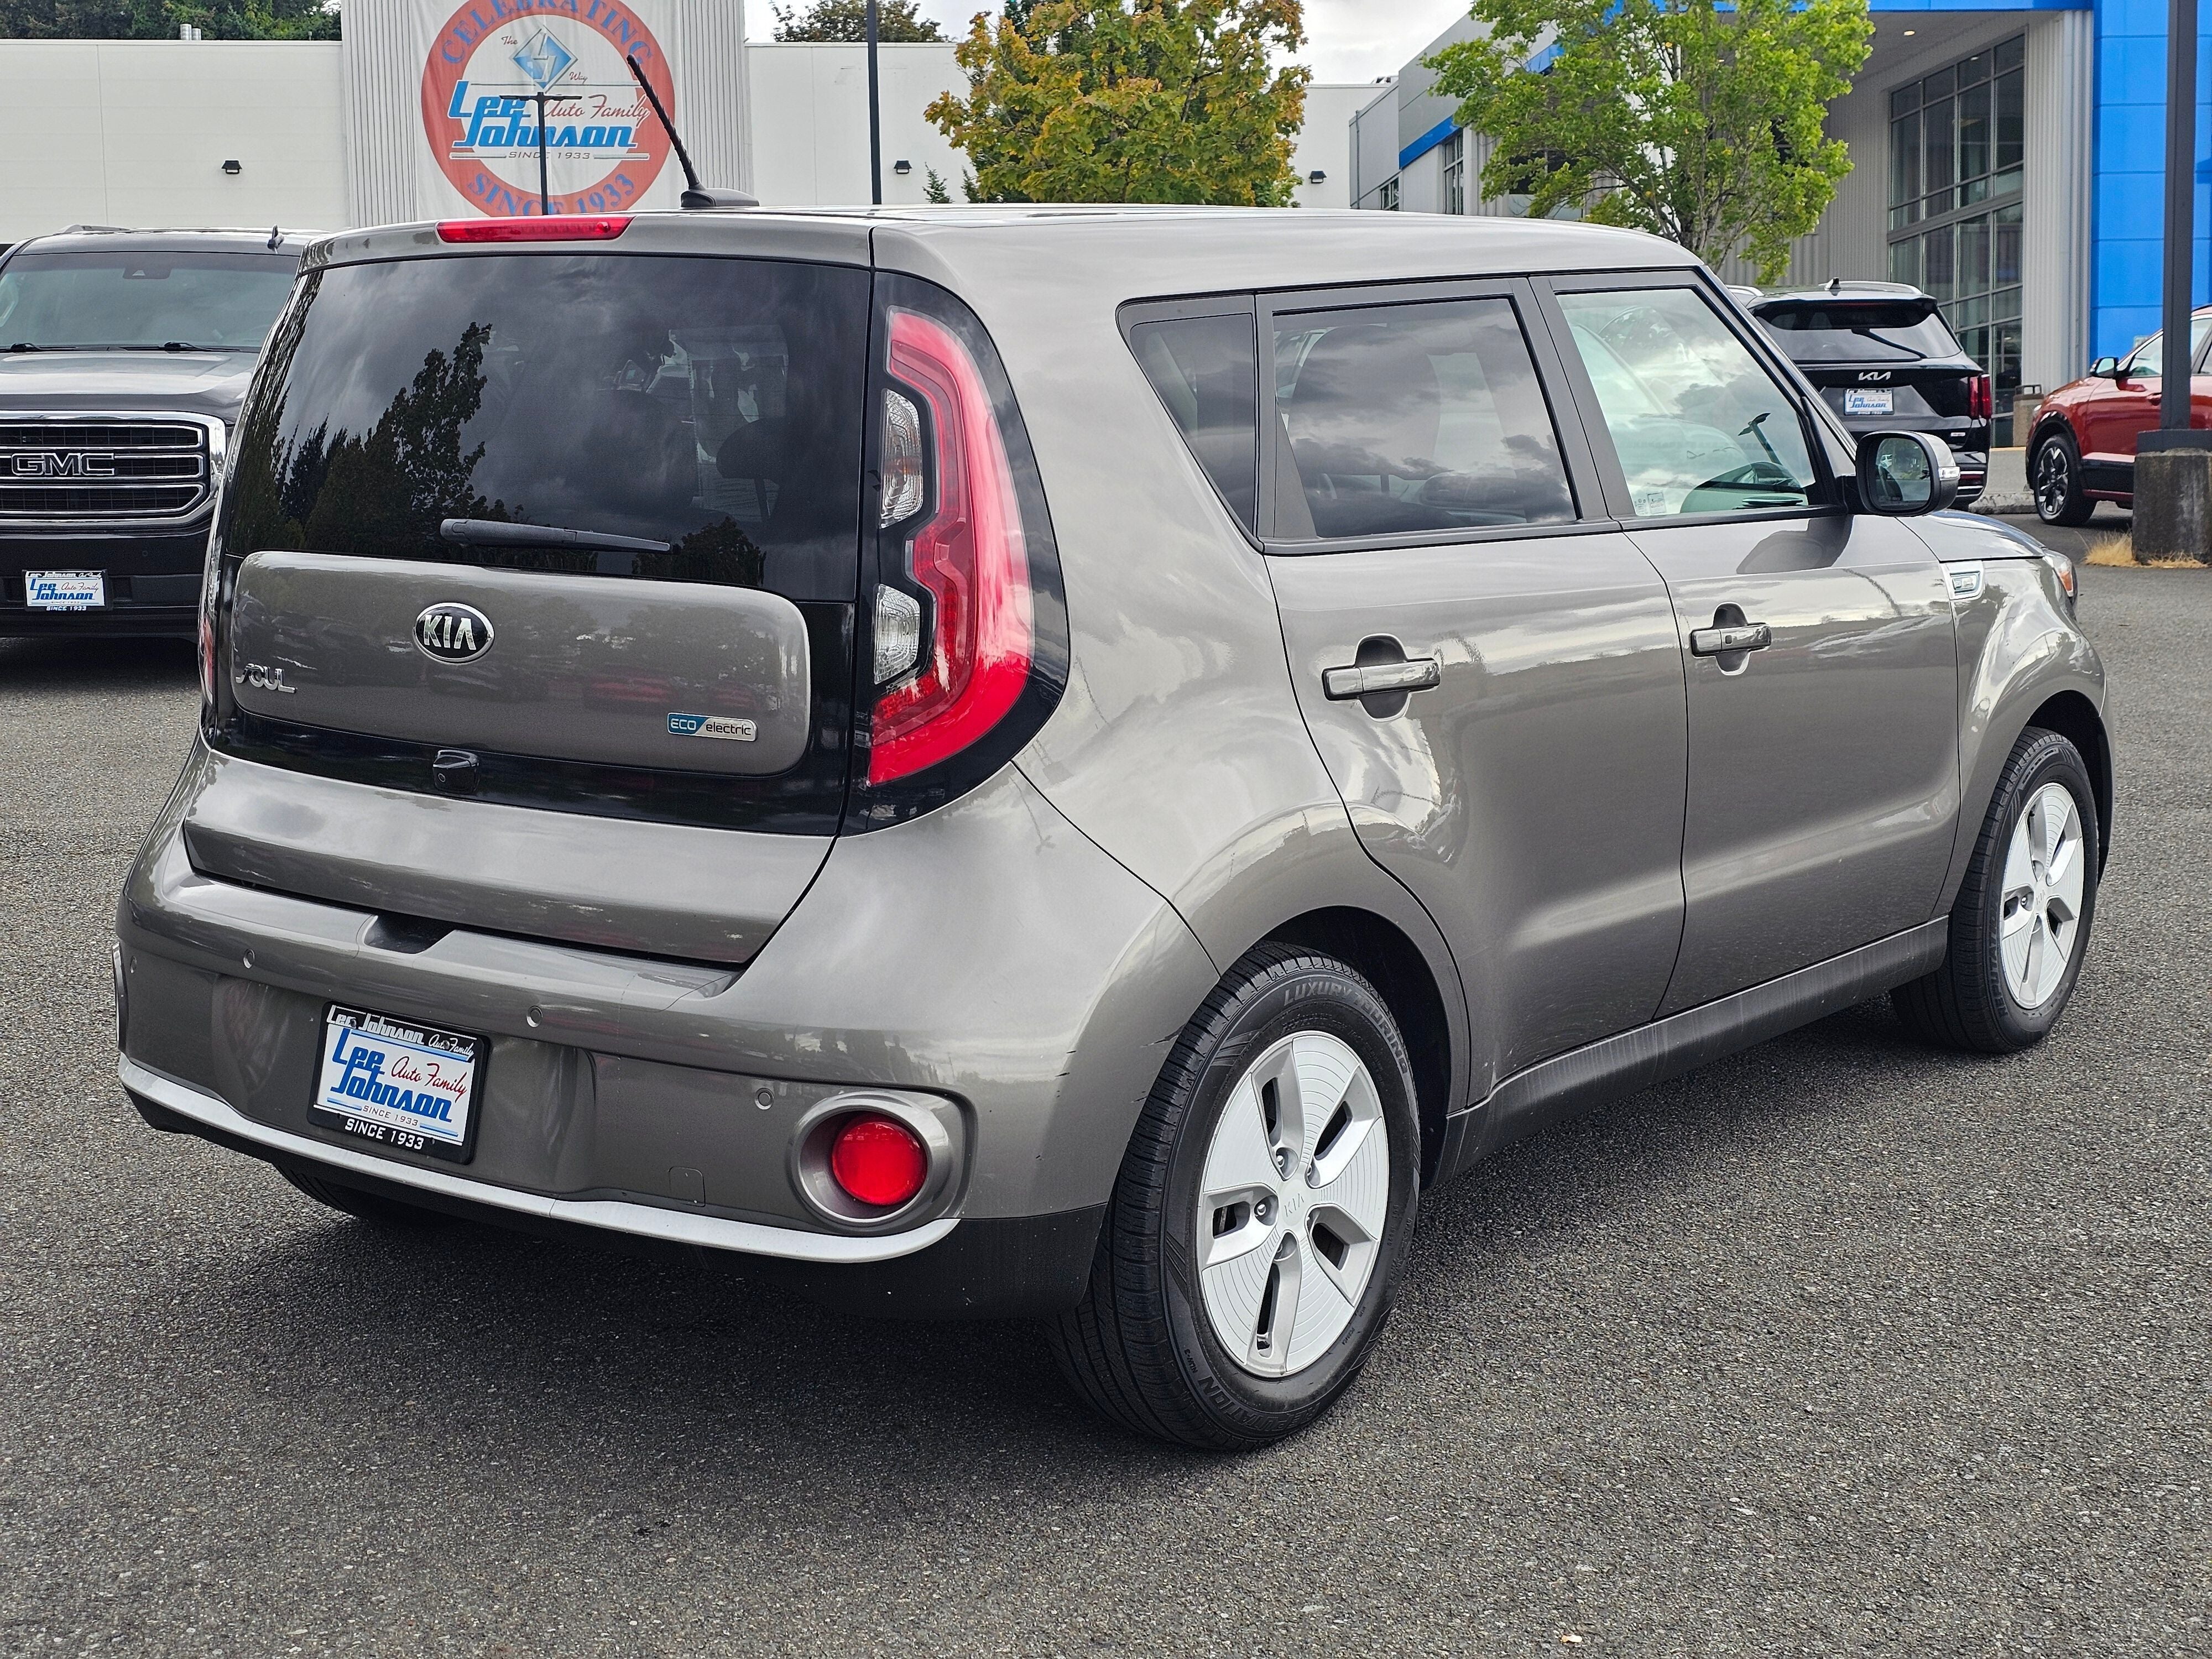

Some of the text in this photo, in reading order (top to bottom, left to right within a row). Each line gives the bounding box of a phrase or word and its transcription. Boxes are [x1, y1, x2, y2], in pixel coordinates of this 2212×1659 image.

[501, 36, 518, 45] The
[569, 72, 588, 84] Way
[450, 81, 531, 118] Lee
[587, 94, 650, 127] Family
[454, 113, 638, 147] Johnson
[577, 173, 634, 213] 1933
[1858, 371, 1891, 381] KIA
[11, 453, 114, 476] GMC
[30, 579, 58, 590] Lee
[77, 582, 98, 593] Family
[32, 588, 95, 600] Johnson
[424, 614, 476, 650] KIA
[236, 663, 297, 693] SOUL
[671, 718, 751, 735] ECO electric
[358, 1013, 424, 1045] Johnson
[428, 1034, 450, 1050] Aut
[450, 1038, 474, 1061] Family
[1284, 981, 1352, 1006] LUXURY
[1354, 992, 1408, 1074] TOURING
[332, 1029, 467, 1103] Lee Auto Family
[330, 1065, 452, 1123] Johnson
[363, 1106, 419, 1126] SINCE 1933
[345, 1118, 424, 1150] SINCE 1933
[1284, 1193, 1305, 1217] KIA
